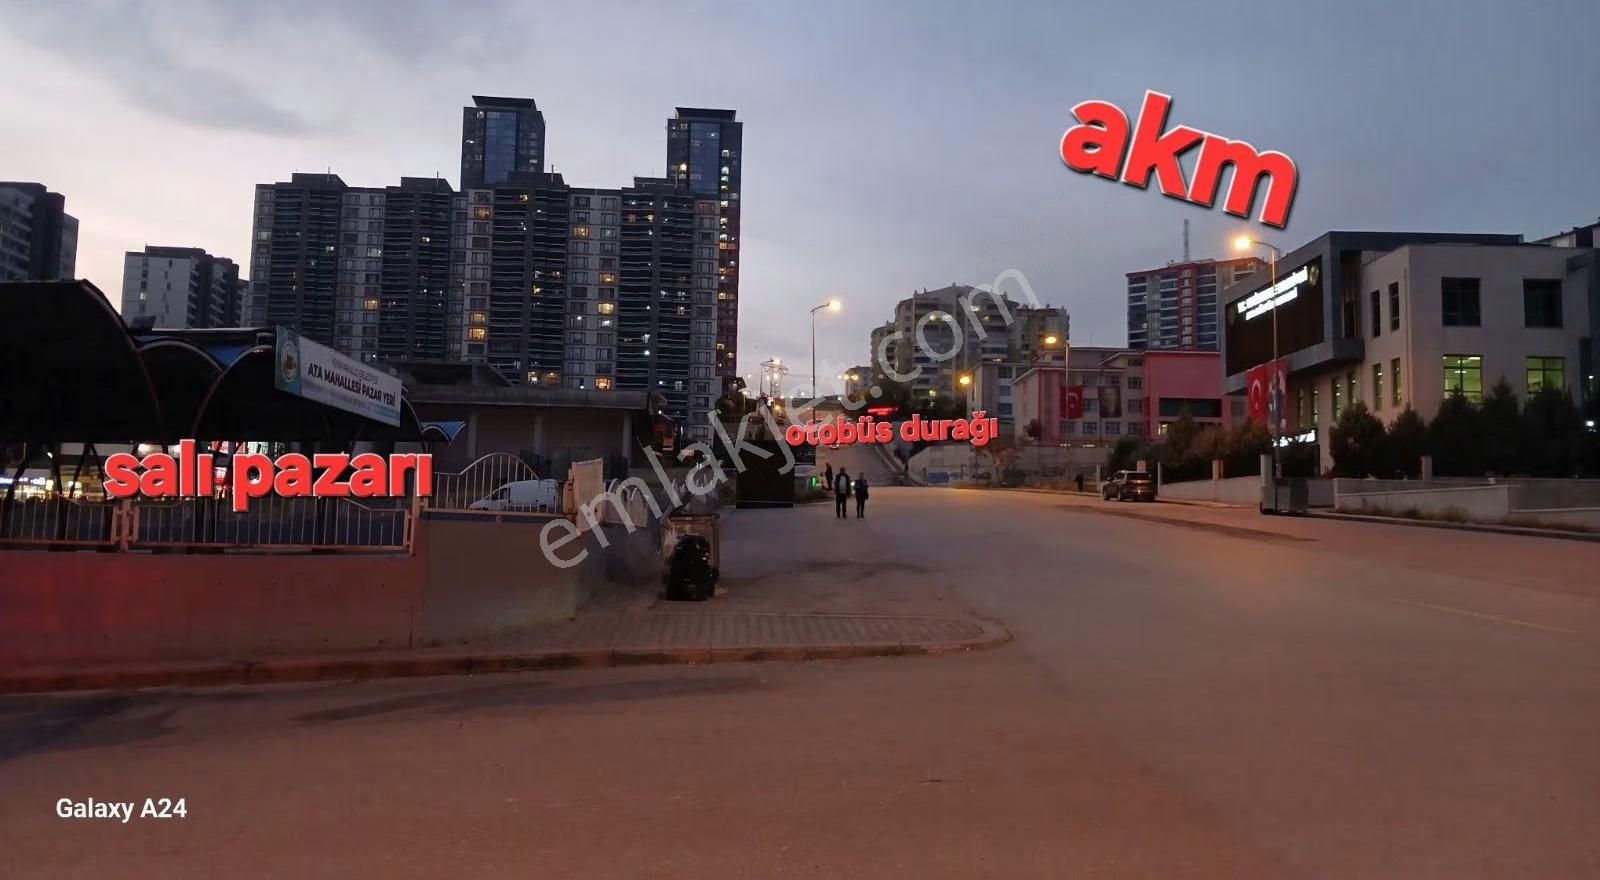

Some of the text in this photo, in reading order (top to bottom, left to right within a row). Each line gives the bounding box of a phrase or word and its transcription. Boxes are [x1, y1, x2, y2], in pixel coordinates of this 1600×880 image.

[308, 363, 323, 380] ATA
[324, 369, 361, 394] MAHALLESİ
[361, 383, 382, 401] PAZAR
[382, 391, 396, 407] YERİ
